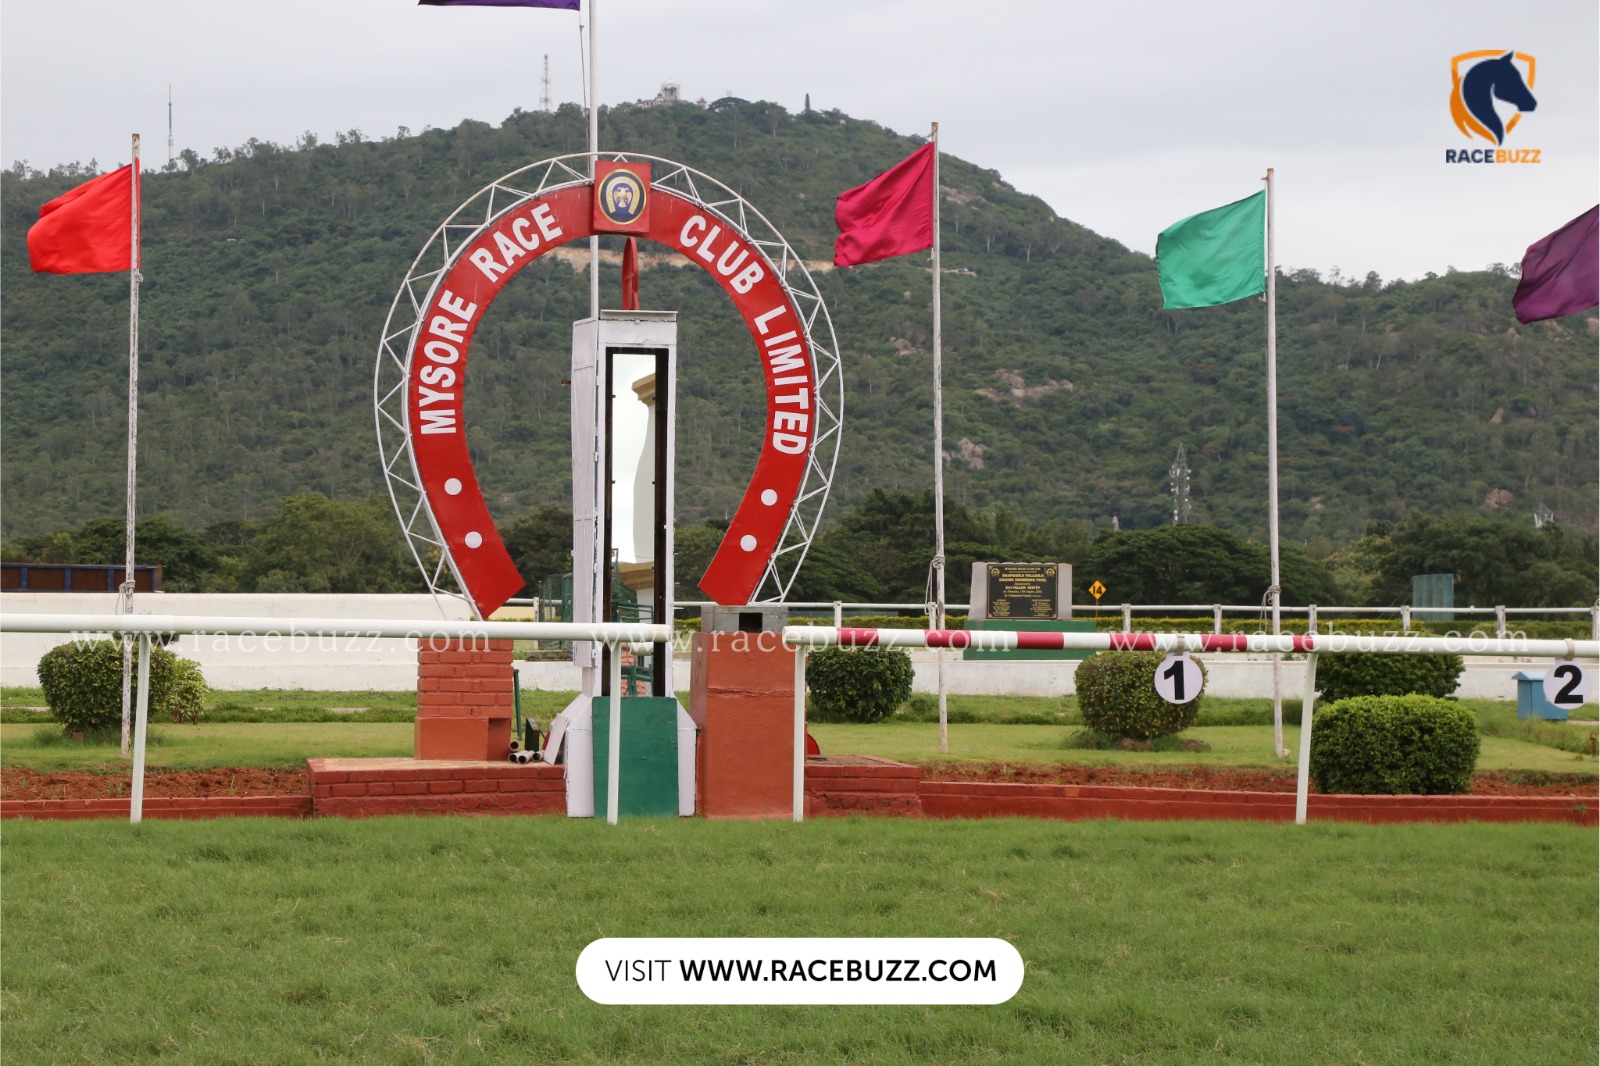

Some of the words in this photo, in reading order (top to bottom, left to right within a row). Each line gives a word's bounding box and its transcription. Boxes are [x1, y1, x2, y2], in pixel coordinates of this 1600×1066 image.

[419, 290, 477, 434] MYSORE
[469, 203, 564, 283] RACE
[679, 215, 764, 295] CLUB
[754, 305, 808, 455] LIMITED
[1092, 585, 1103, 595] 14
[1163, 660, 1186, 700] 1
[1553, 664, 1584, 704] 2
